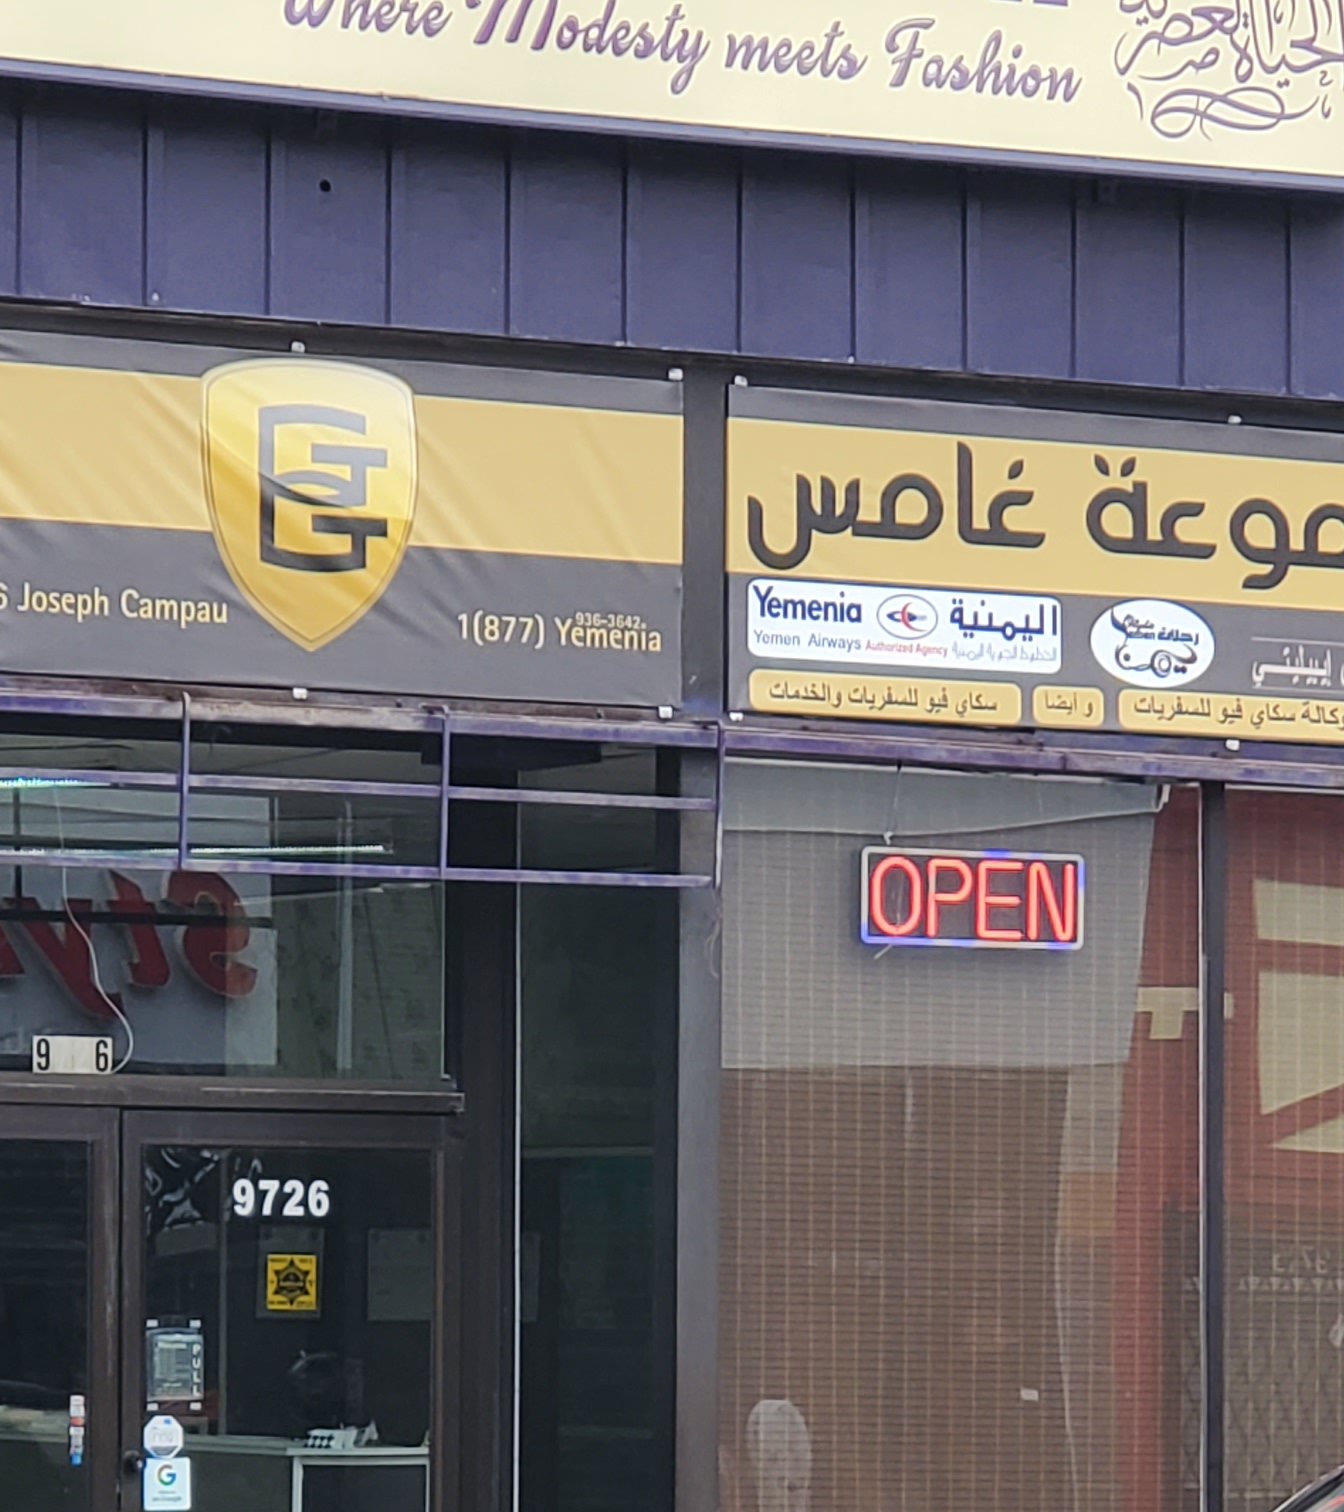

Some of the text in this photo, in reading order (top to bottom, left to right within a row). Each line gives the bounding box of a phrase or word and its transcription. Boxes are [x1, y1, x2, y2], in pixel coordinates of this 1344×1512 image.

[726, 20, 869, 80] meets
[884, 17, 1081, 103] Fashion
[747, 441, 1046, 570] غامس
[17, 582, 109, 623] Joseph
[120, 588, 228, 629] Campau
[753, 585, 862, 623] Yemenia
[949, 598, 1057, 641] اليمنية
[457, 609, 662, 652] 1(877) Yemenia
[754, 629, 862, 653] Yemen Airways
[865, 639, 948, 659] Authorized Agency
[769, 682, 843, 708] والخدمات
[925, 686, 949, 713] فيو
[955, 692, 998, 718] سكاي
[1217, 700, 1244, 725] فيو
[1250, 700, 1296, 729] سكاي
[868, 856, 1076, 941] OPEN
[233, 1178, 330, 1217] 9726
